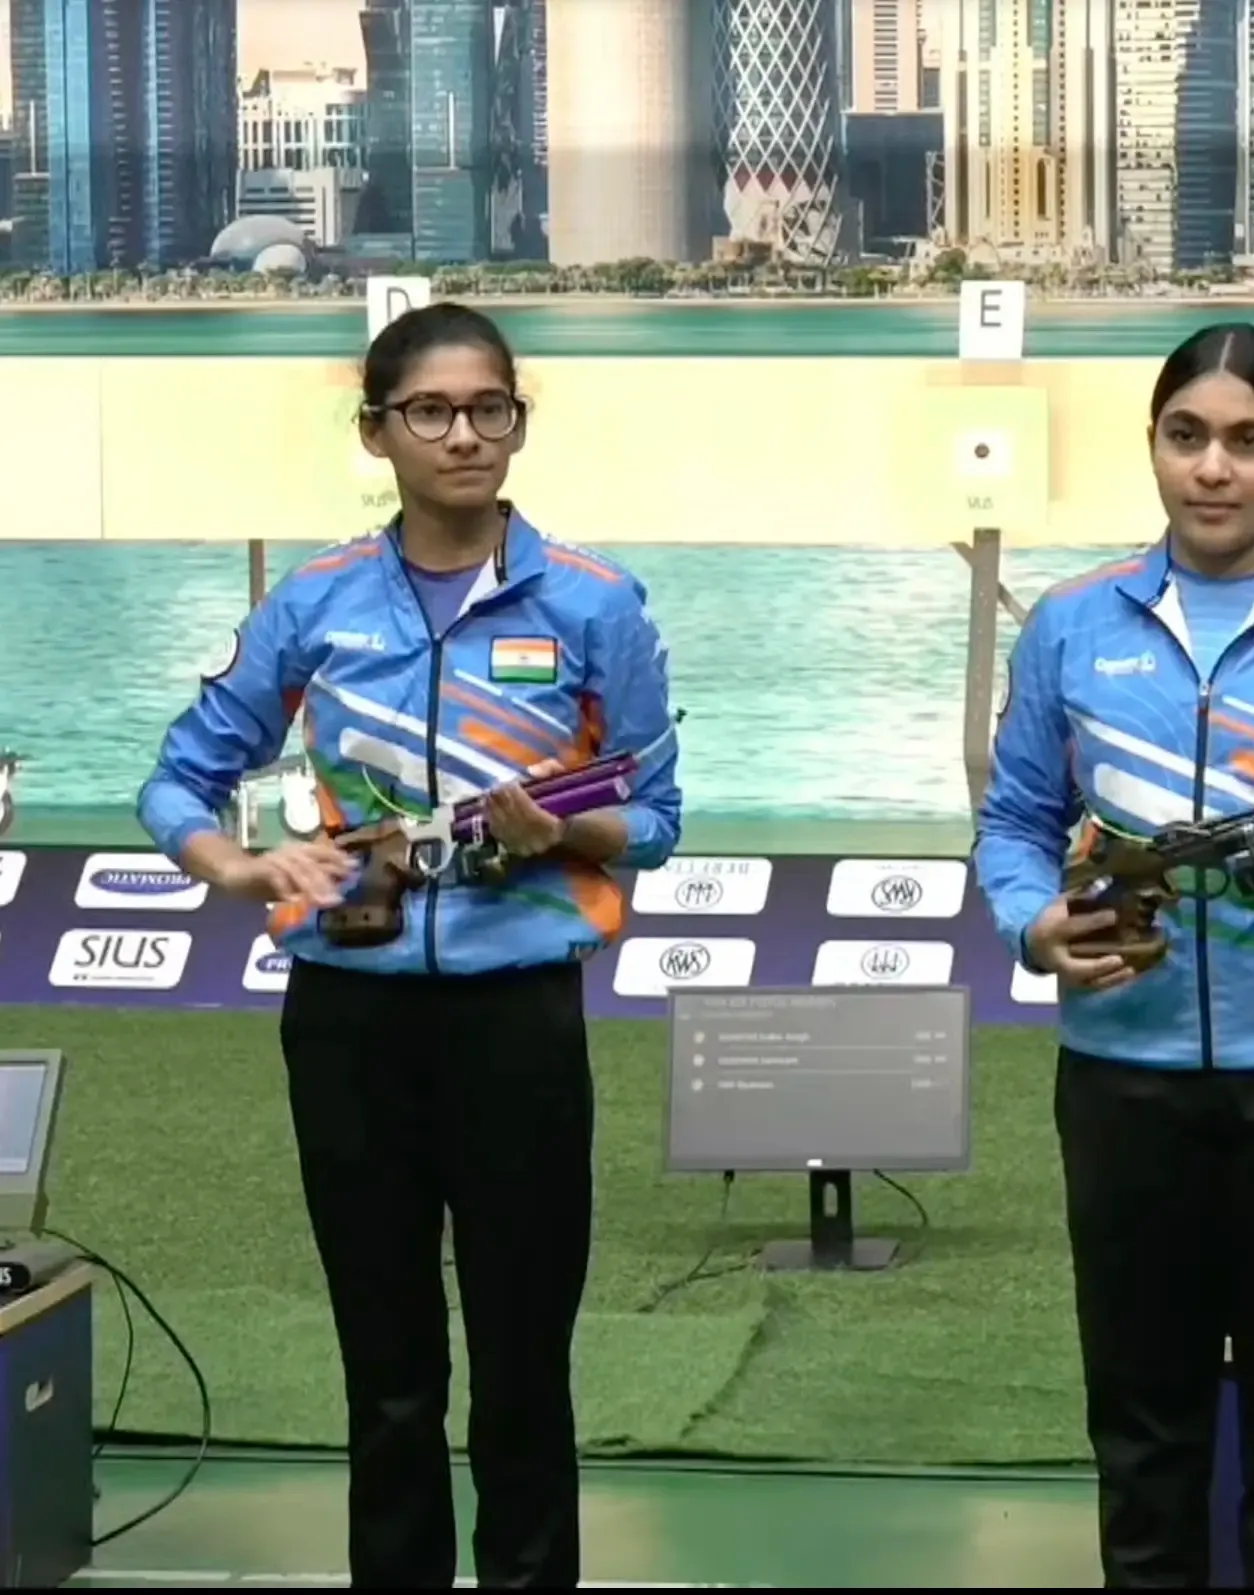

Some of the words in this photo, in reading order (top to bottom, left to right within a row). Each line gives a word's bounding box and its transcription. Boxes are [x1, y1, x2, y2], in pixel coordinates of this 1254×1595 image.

[386, 286, 411, 325] D
[980, 289, 1002, 328] E
[73, 934, 170, 969] SIUS
